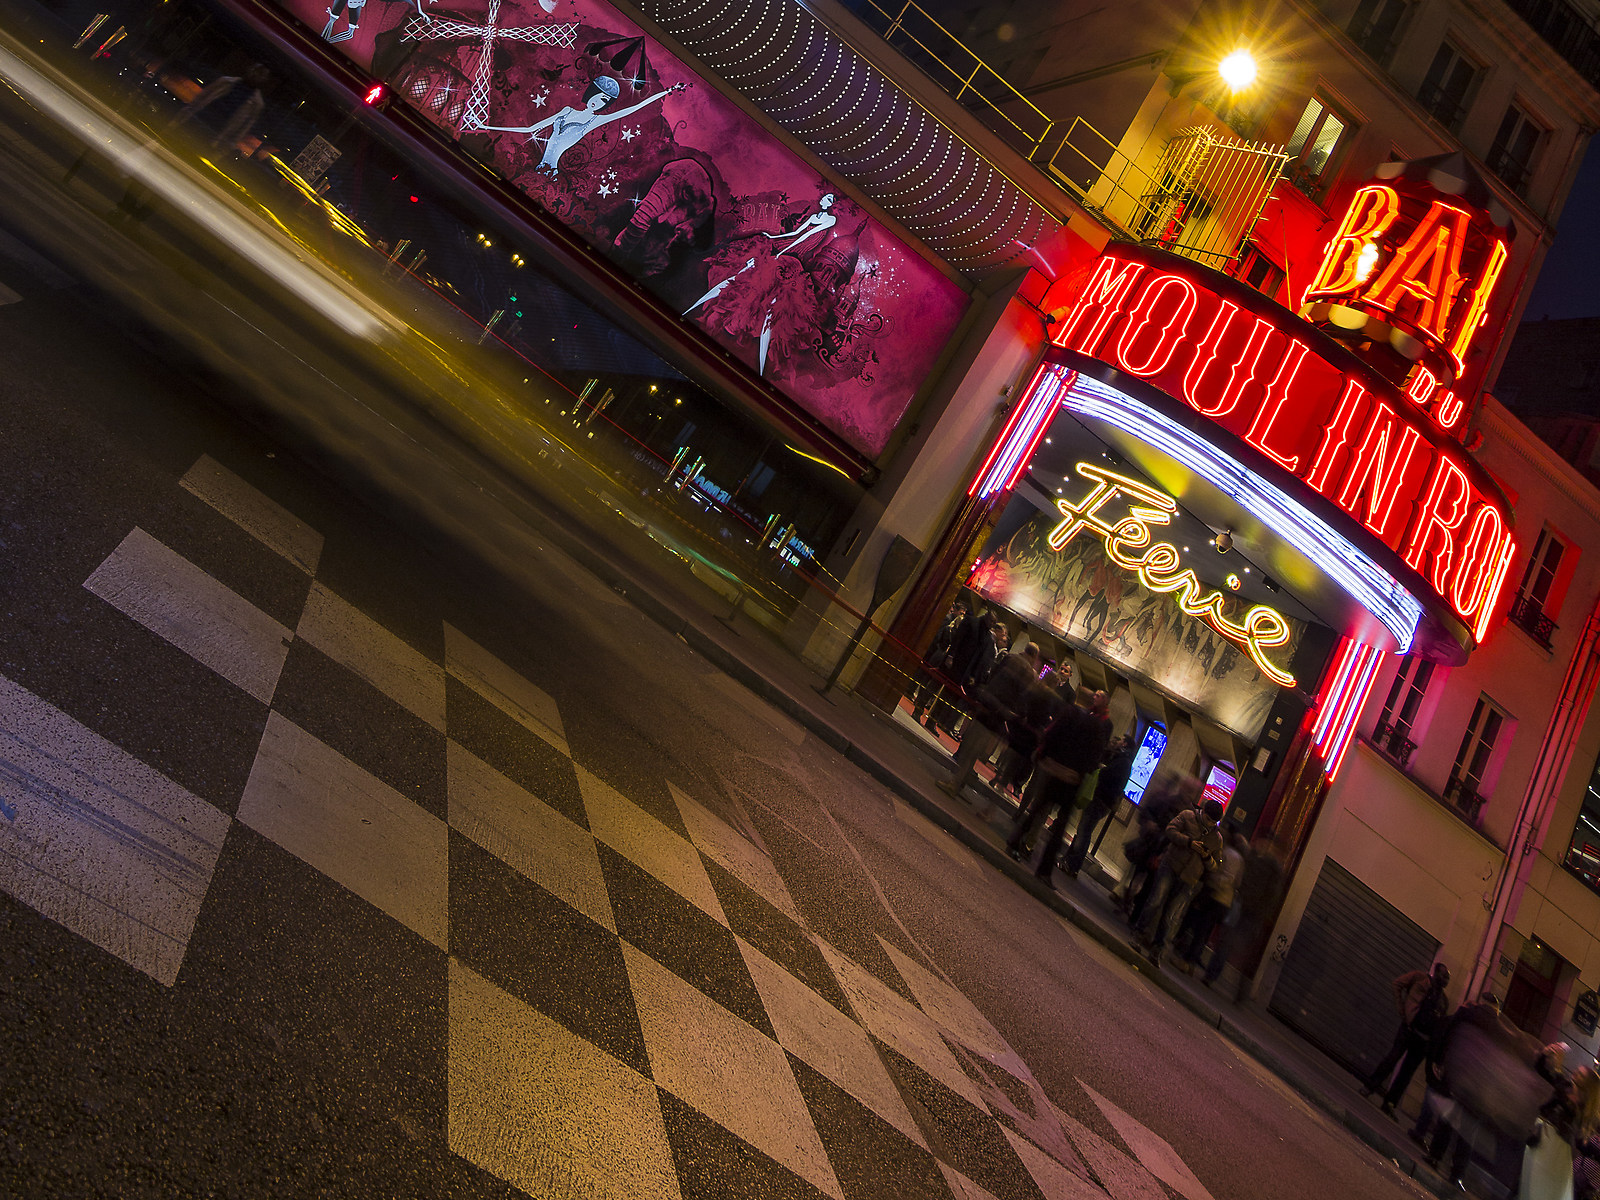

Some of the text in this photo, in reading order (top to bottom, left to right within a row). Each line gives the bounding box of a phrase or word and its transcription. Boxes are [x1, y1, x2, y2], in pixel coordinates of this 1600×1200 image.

[1055, 255, 1516, 644] MOULIN RO
[1409, 366, 1464, 428] DU
[1047, 461, 1296, 688] Féerie
